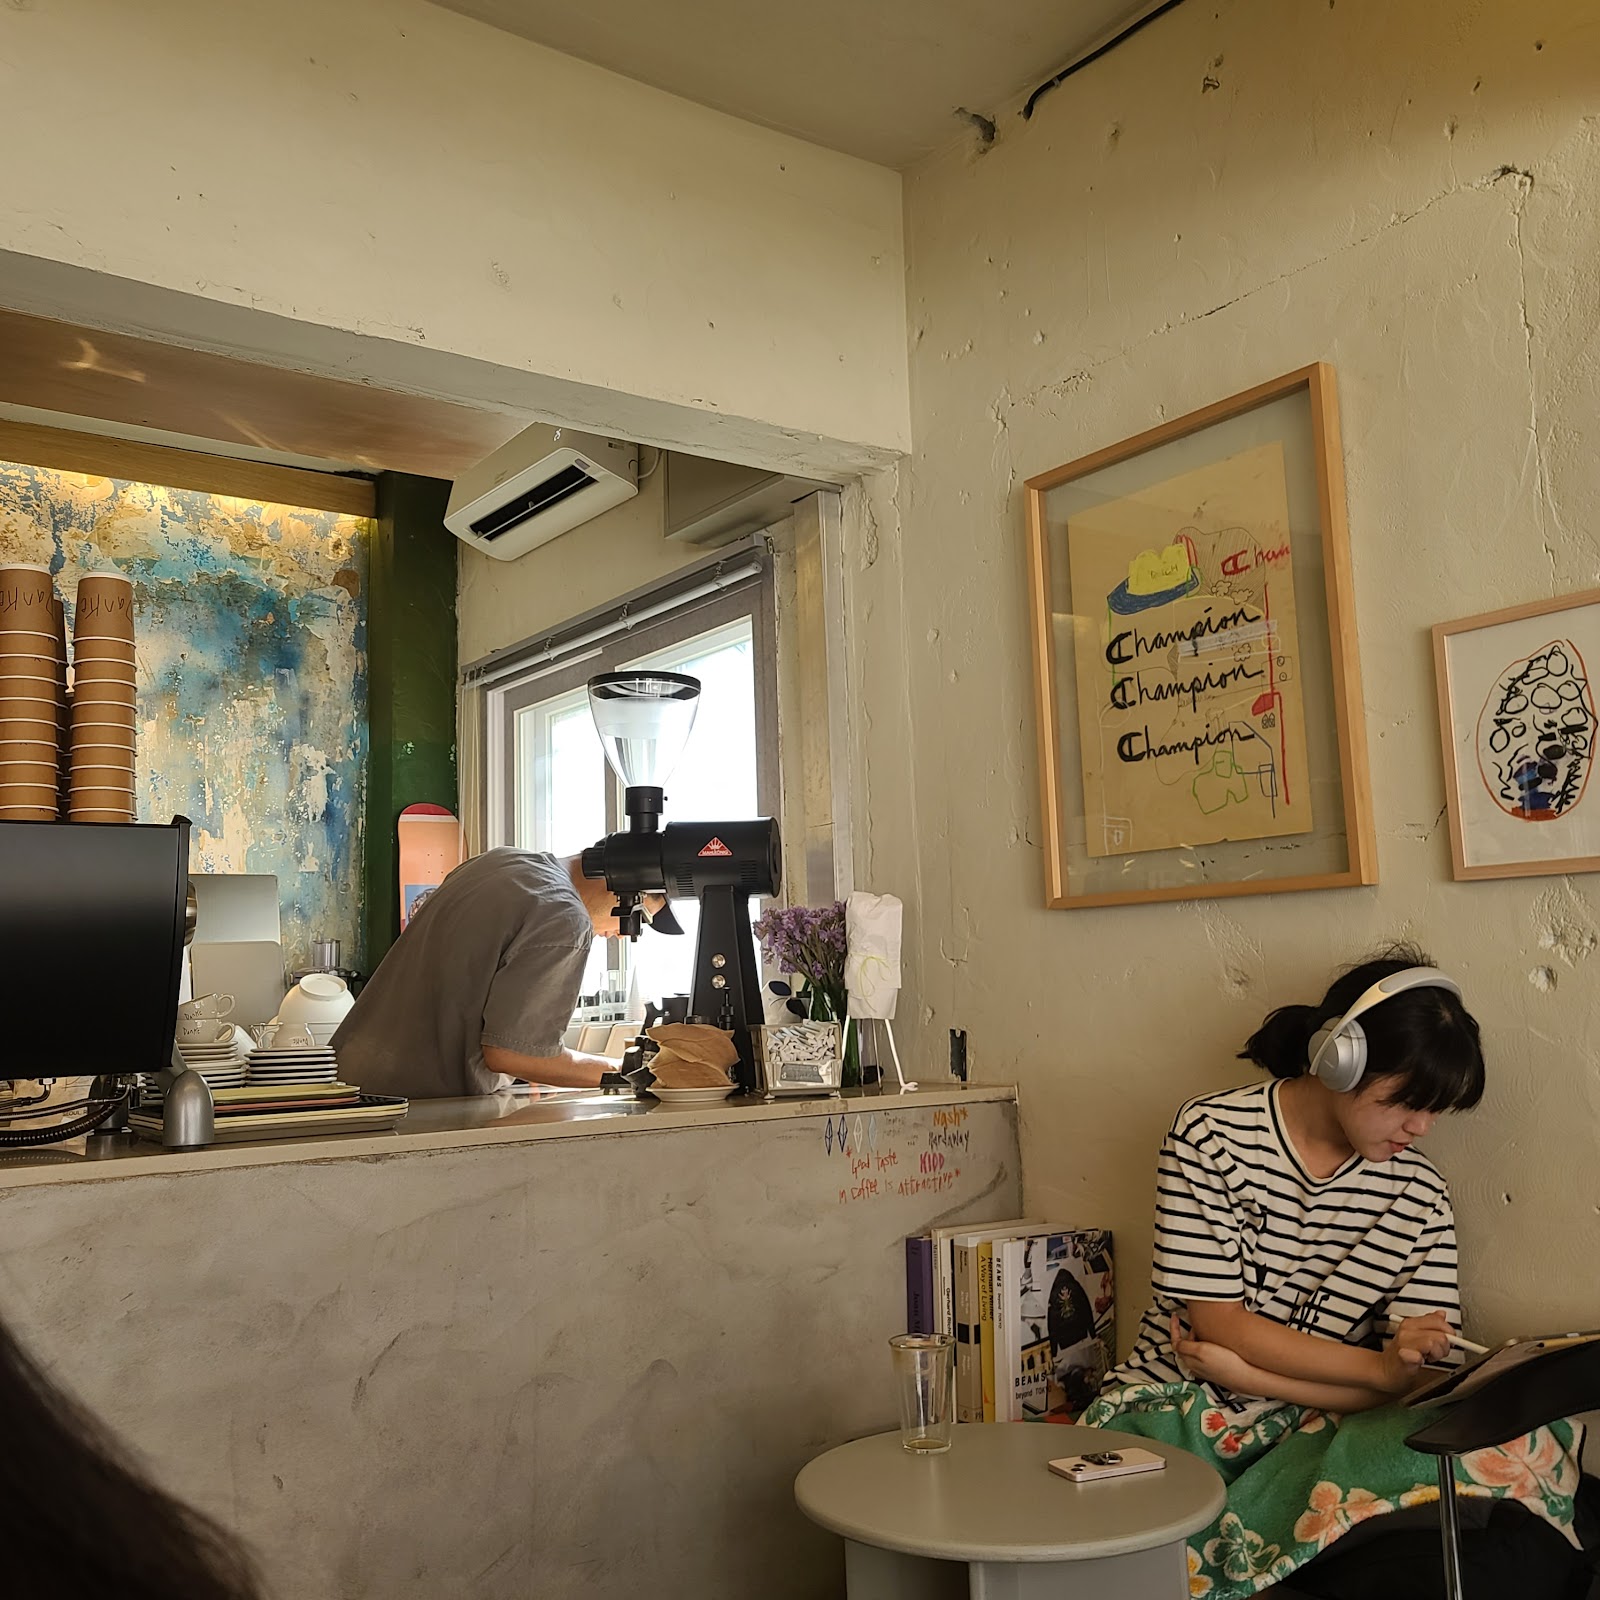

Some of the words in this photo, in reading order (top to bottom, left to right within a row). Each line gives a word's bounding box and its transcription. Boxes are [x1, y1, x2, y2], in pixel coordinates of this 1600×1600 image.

[1106, 607, 1262, 666] Champion
[1110, 662, 1265, 713] Champion
[1116, 723, 1256, 765] Champion
[980, 1255, 987, 1263] A
[981, 1284, 988, 1294] of
[981, 1295, 989, 1322] Living
[1015, 1371, 1047, 1387] BEAMS
[1015, 1389, 1033, 1400] beyond
